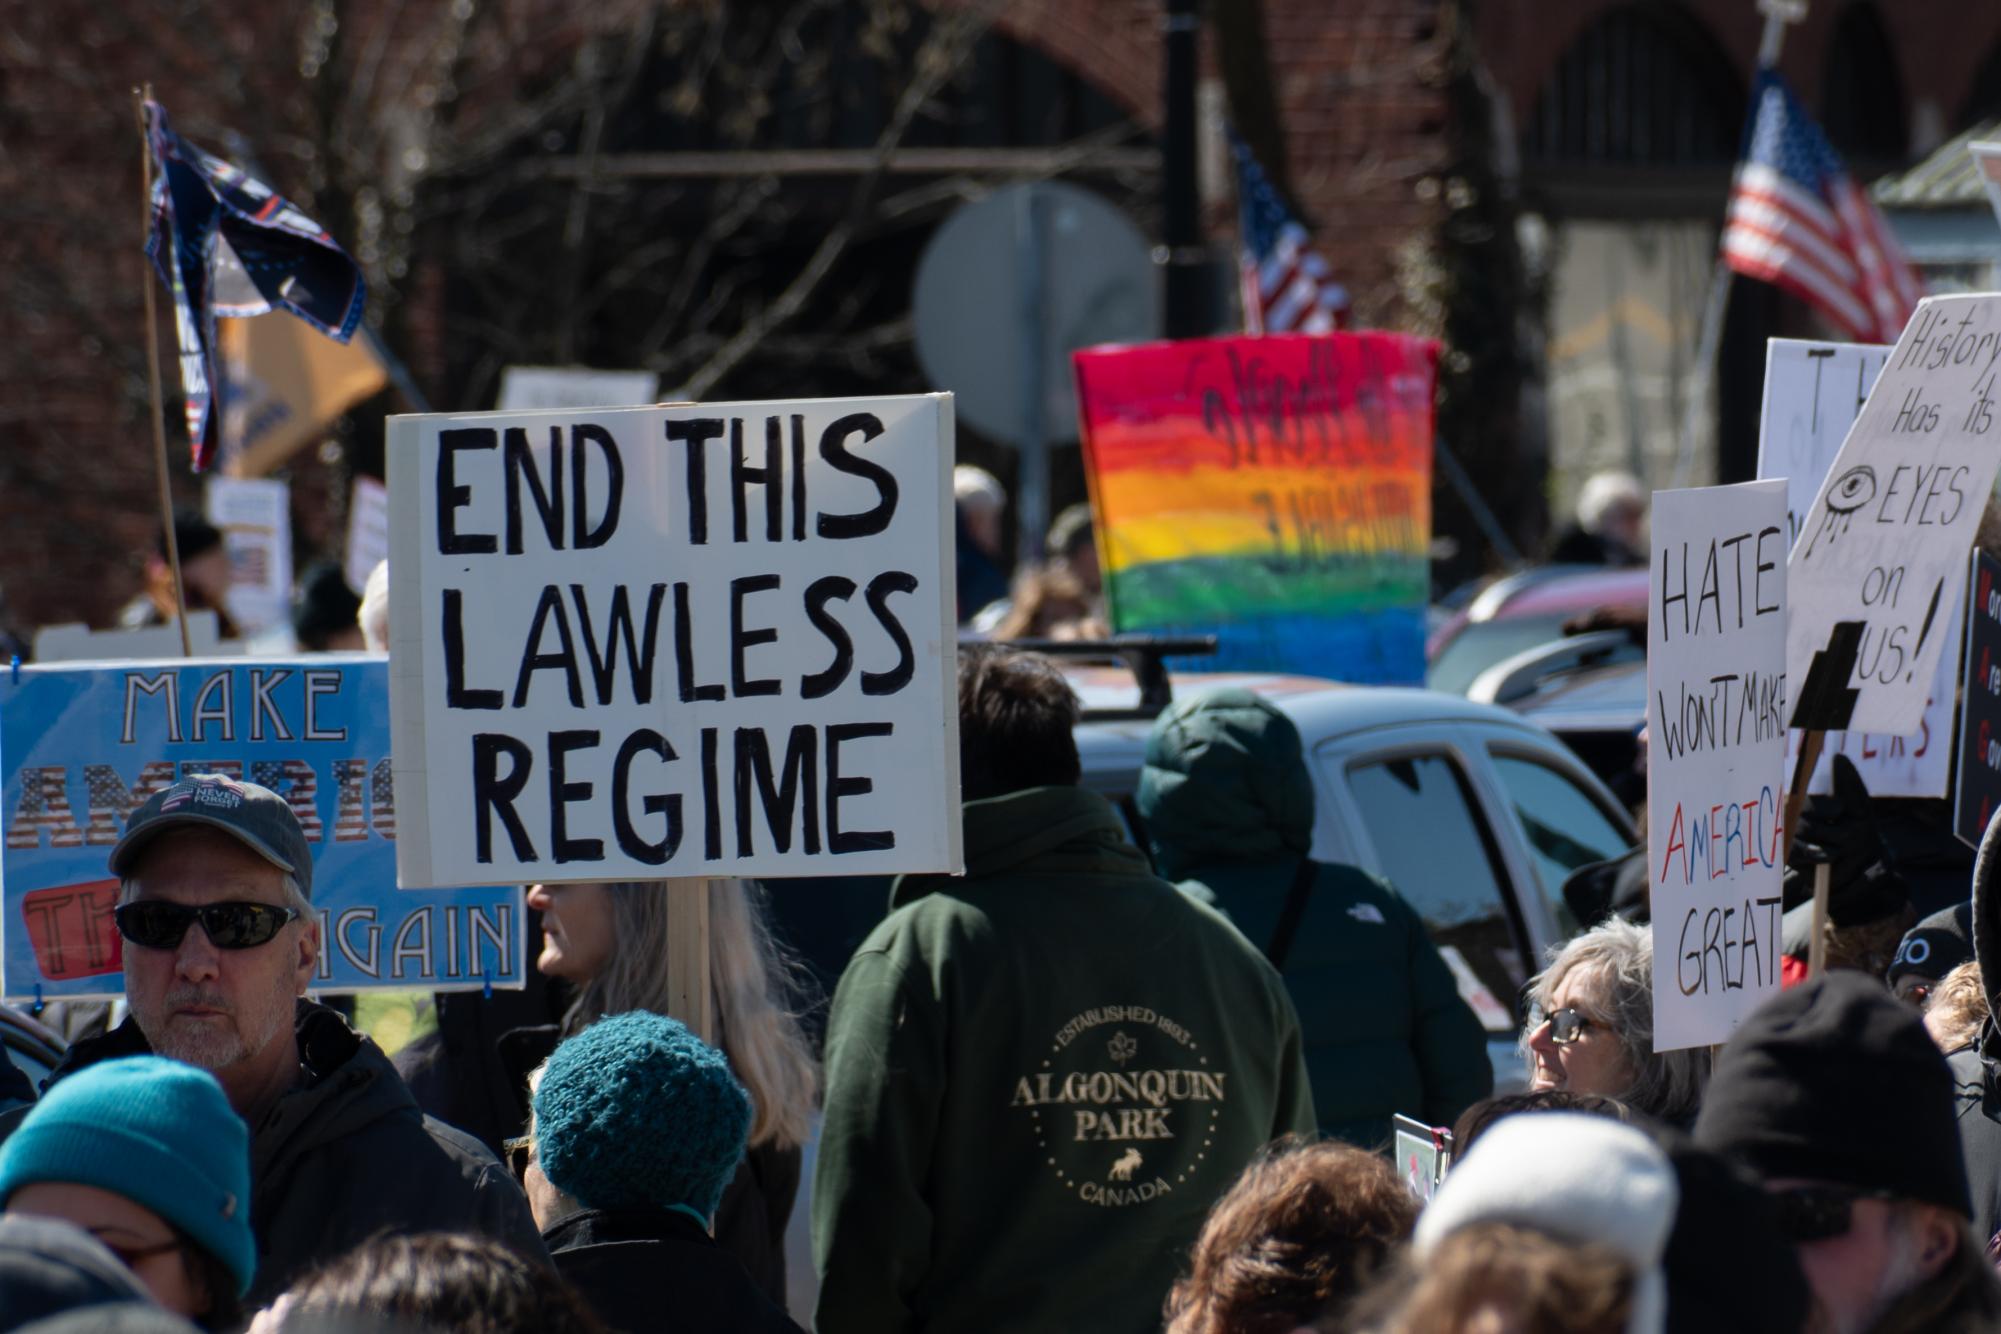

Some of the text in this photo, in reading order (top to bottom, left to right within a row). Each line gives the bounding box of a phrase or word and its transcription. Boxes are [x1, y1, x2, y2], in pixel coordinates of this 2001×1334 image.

[1898, 303, 2001, 392] History
[1891, 387, 1942, 433] Has
[1962, 373, 1996, 435] its
[436, 424, 624, 555] END
[666, 412, 899, 545] THIS
[1876, 464, 1970, 526] EYES
[1662, 526, 1781, 642] HATE
[1861, 565, 1905, 609] on
[442, 570, 919, 709] LAWLESS
[1858, 575, 1945, 685] US!
[120, 669, 348, 744] MAKE
[1658, 674, 1739, 761] WON'T
[1736, 670, 1786, 744] MAKE
[194, 795, 241, 809] FORGET
[196, 787, 241, 802] NEVER
[472, 722, 895, 865] REGIME
[1661, 782, 1783, 886] AMERICA
[1677, 896, 1782, 997] GREAT
[1055, 1005, 1191, 1047] ESTABLISHED 1893
[1010, 1069, 1227, 1108] ALGONQUIN
[1073, 1108, 1175, 1142] PARK
[1079, 1175, 1173, 1208] CANADA
